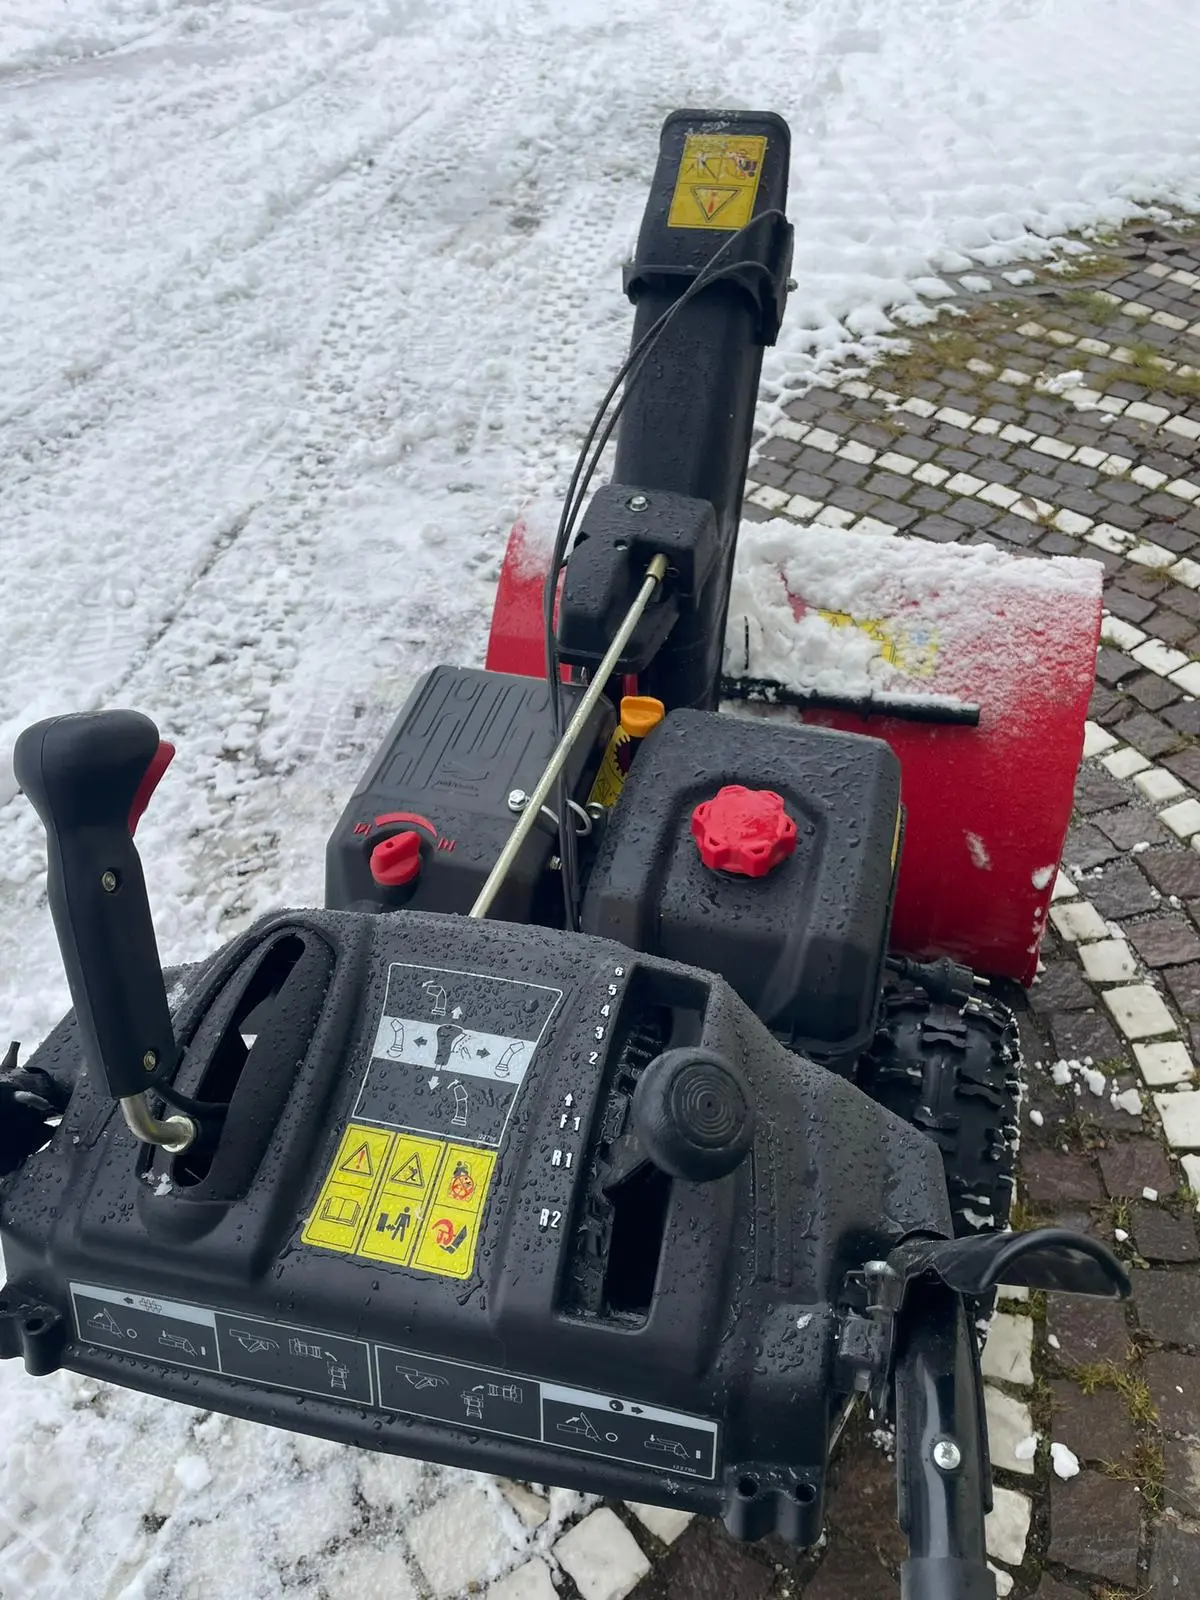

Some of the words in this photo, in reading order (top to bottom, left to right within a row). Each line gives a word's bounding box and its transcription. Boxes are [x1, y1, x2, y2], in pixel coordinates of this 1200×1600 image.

[614, 966, 624, 977] 6
[608, 984, 617, 996] 5
[600, 1004, 610, 1018] 4
[595, 1026, 604, 1040] 3
[588, 1052, 598, 1065] 2
[552, 1150, 573, 1169] R1
[539, 1208, 561, 1228] R2
